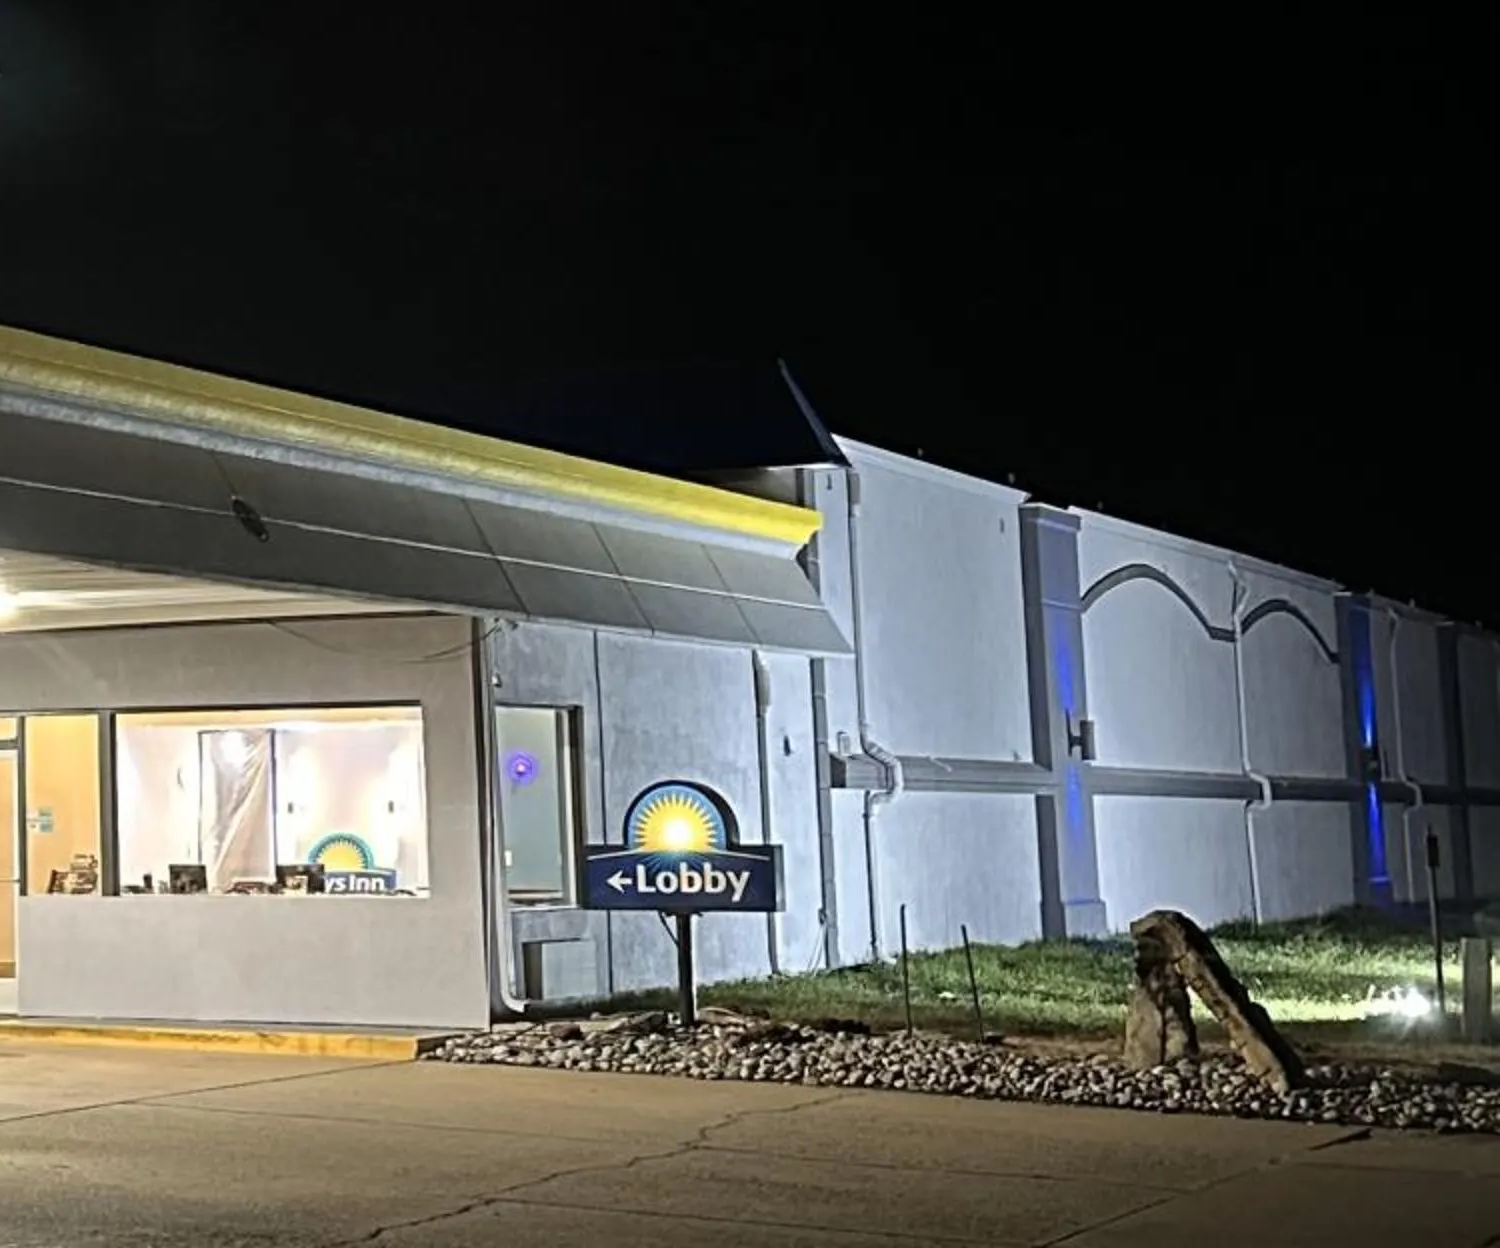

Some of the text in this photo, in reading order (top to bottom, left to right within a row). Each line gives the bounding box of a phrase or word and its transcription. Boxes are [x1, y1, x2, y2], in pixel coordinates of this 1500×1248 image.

[324, 873, 385, 893] ys Inn
[636, 862, 750, 902] Lobby
